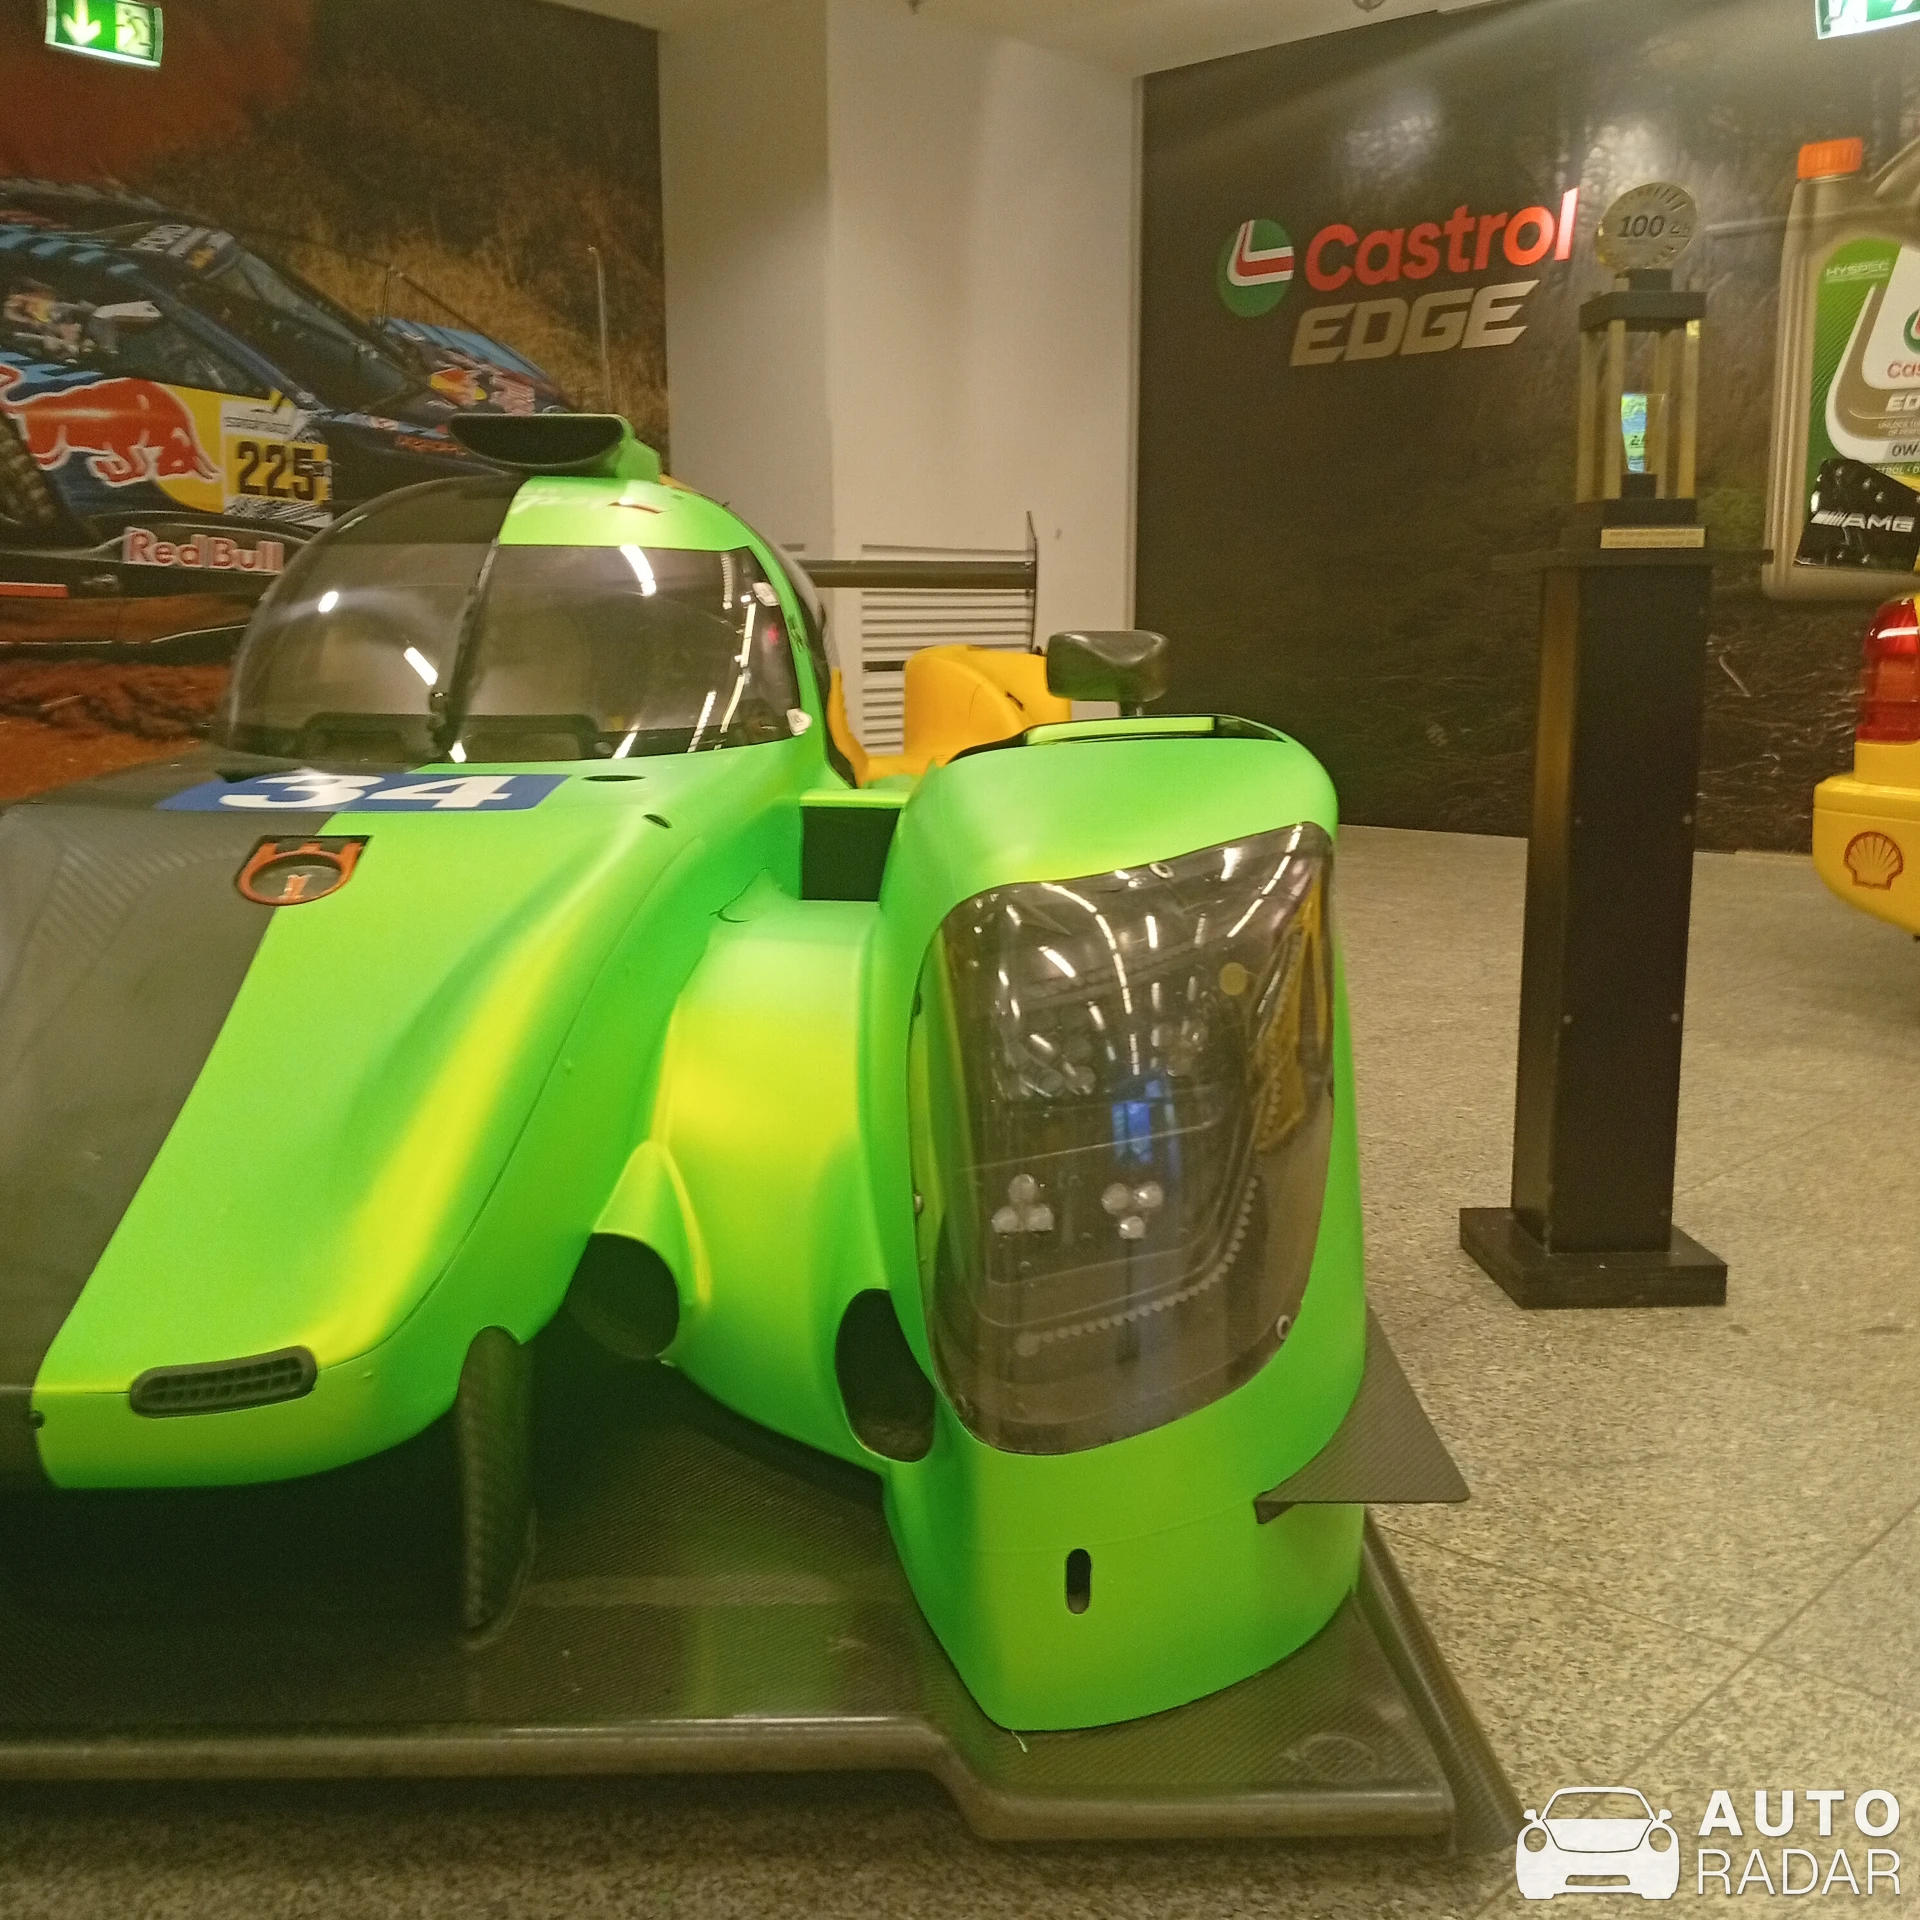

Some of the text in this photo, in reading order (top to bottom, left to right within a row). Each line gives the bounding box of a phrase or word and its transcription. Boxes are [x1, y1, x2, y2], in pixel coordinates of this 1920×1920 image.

[1304, 186, 1579, 291] Castrol
[1618, 215, 1666, 238] 100
[1825, 261, 1890, 278] HYSPEC
[1290, 280, 1540, 367] EDGE
[237, 441, 315, 501] 225
[1842, 512, 1916, 532] AMG
[219, 775, 519, 808] 34
